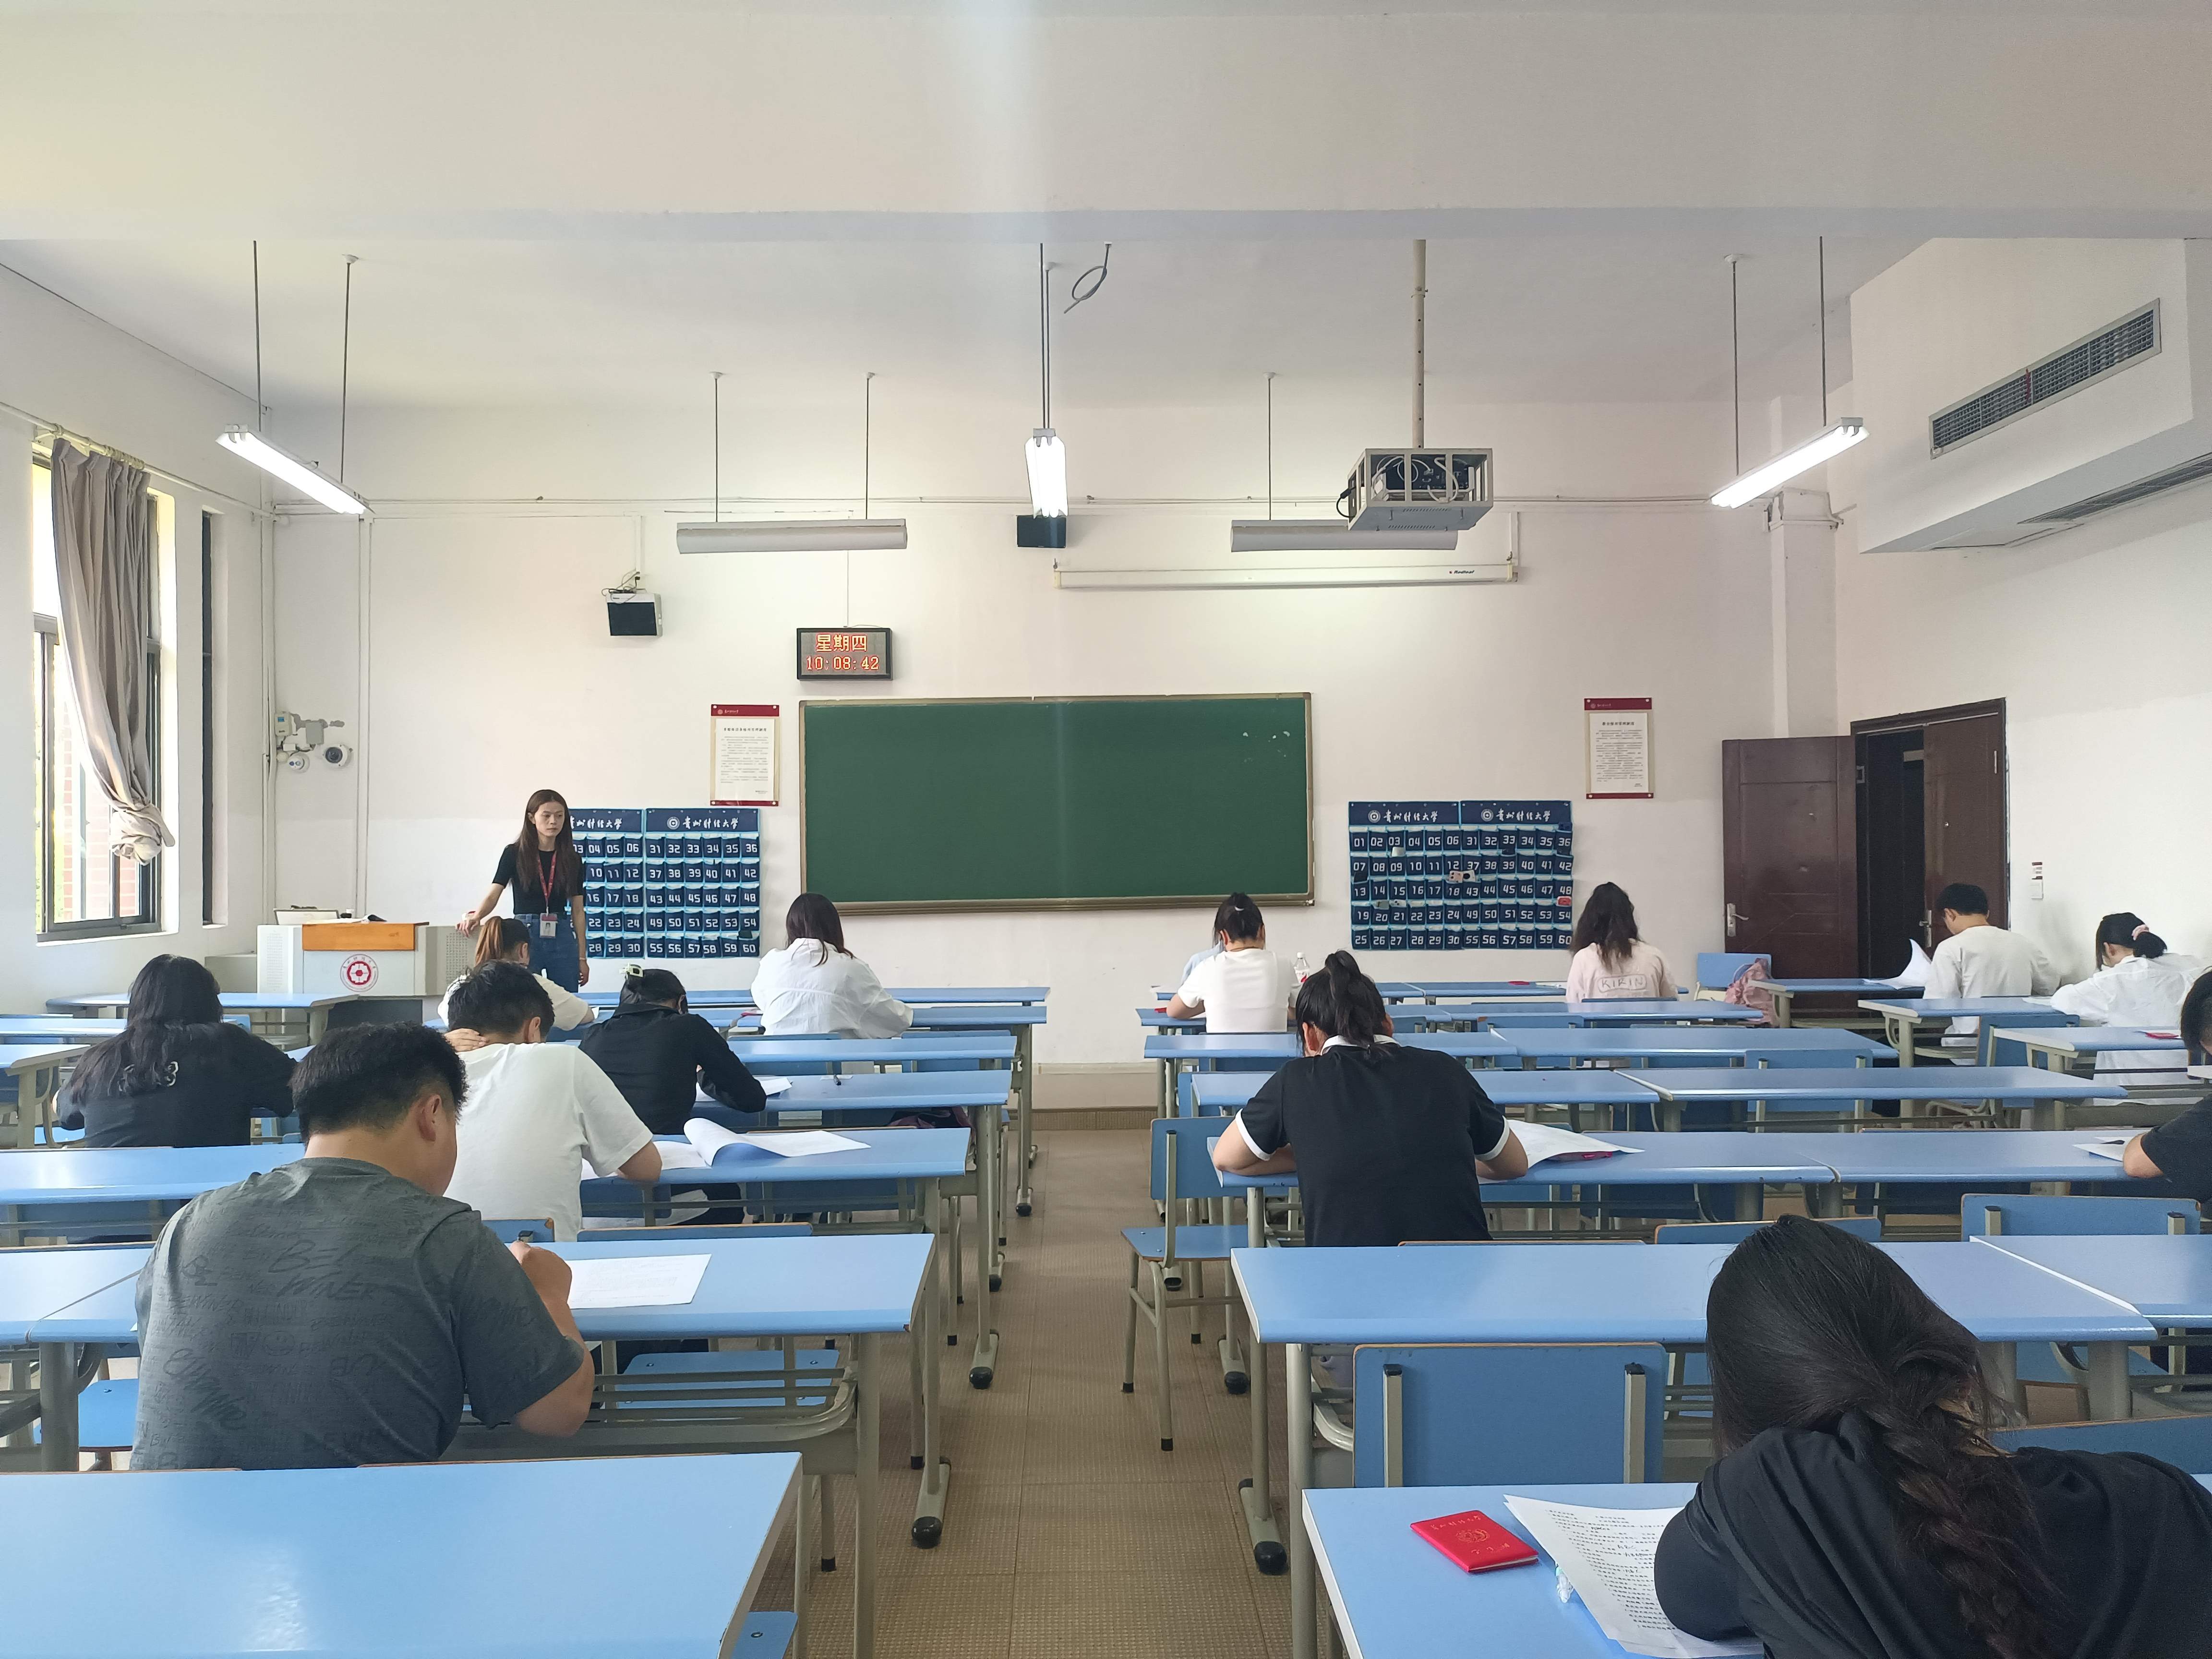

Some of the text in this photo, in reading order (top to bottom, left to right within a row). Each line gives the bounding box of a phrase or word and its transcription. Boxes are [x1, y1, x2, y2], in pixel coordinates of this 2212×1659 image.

[816, 634, 867, 651] 星期四
[807, 656, 879, 670] 10:08:42
[1354, 836, 1459, 847] 01 02 03 04 05 06
[1467, 835, 1571, 847] 31 32 33 34 35 36
[588, 844, 601, 854] 04
[606, 844, 620, 854] 05
[626, 843, 639, 853] 06
[649, 843, 757, 854] 31 32 33 34 35 36
[1353, 861, 1459, 872] 07 08 09 10 11 12
[1467, 861, 1572, 871] 37 38 39 40 41 42
[590, 868, 639, 878] 10 11 12
[649, 868, 757, 878] 37 38 39 40 41 42
[1354, 886, 1460, 897] 13 14 15 16 17 18
[1466, 884, 1572, 896] 43 44 45 46 47 48
[587, 893, 639, 903] 16 17 18
[650, 893, 756, 904] 43 44 45 46 47 48
[1358, 910, 1459, 922] 19 20 21 22 23 24
[1467, 910, 1571, 920] 49 50 51 52 53 54
[589, 918, 640, 928] 22 23 24
[650, 918, 757, 927] 49 50 51 52 53 54
[1355, 935, 1460, 946] 25 26 27 28 29 30
[1466, 935, 1572, 945] 55 56 57 58 59 60
[588, 943, 640, 953] 28 29 30
[649, 943, 756, 954] 55 56 57 58 59 60
[1602, 977, 1643, 989] KIRIN
